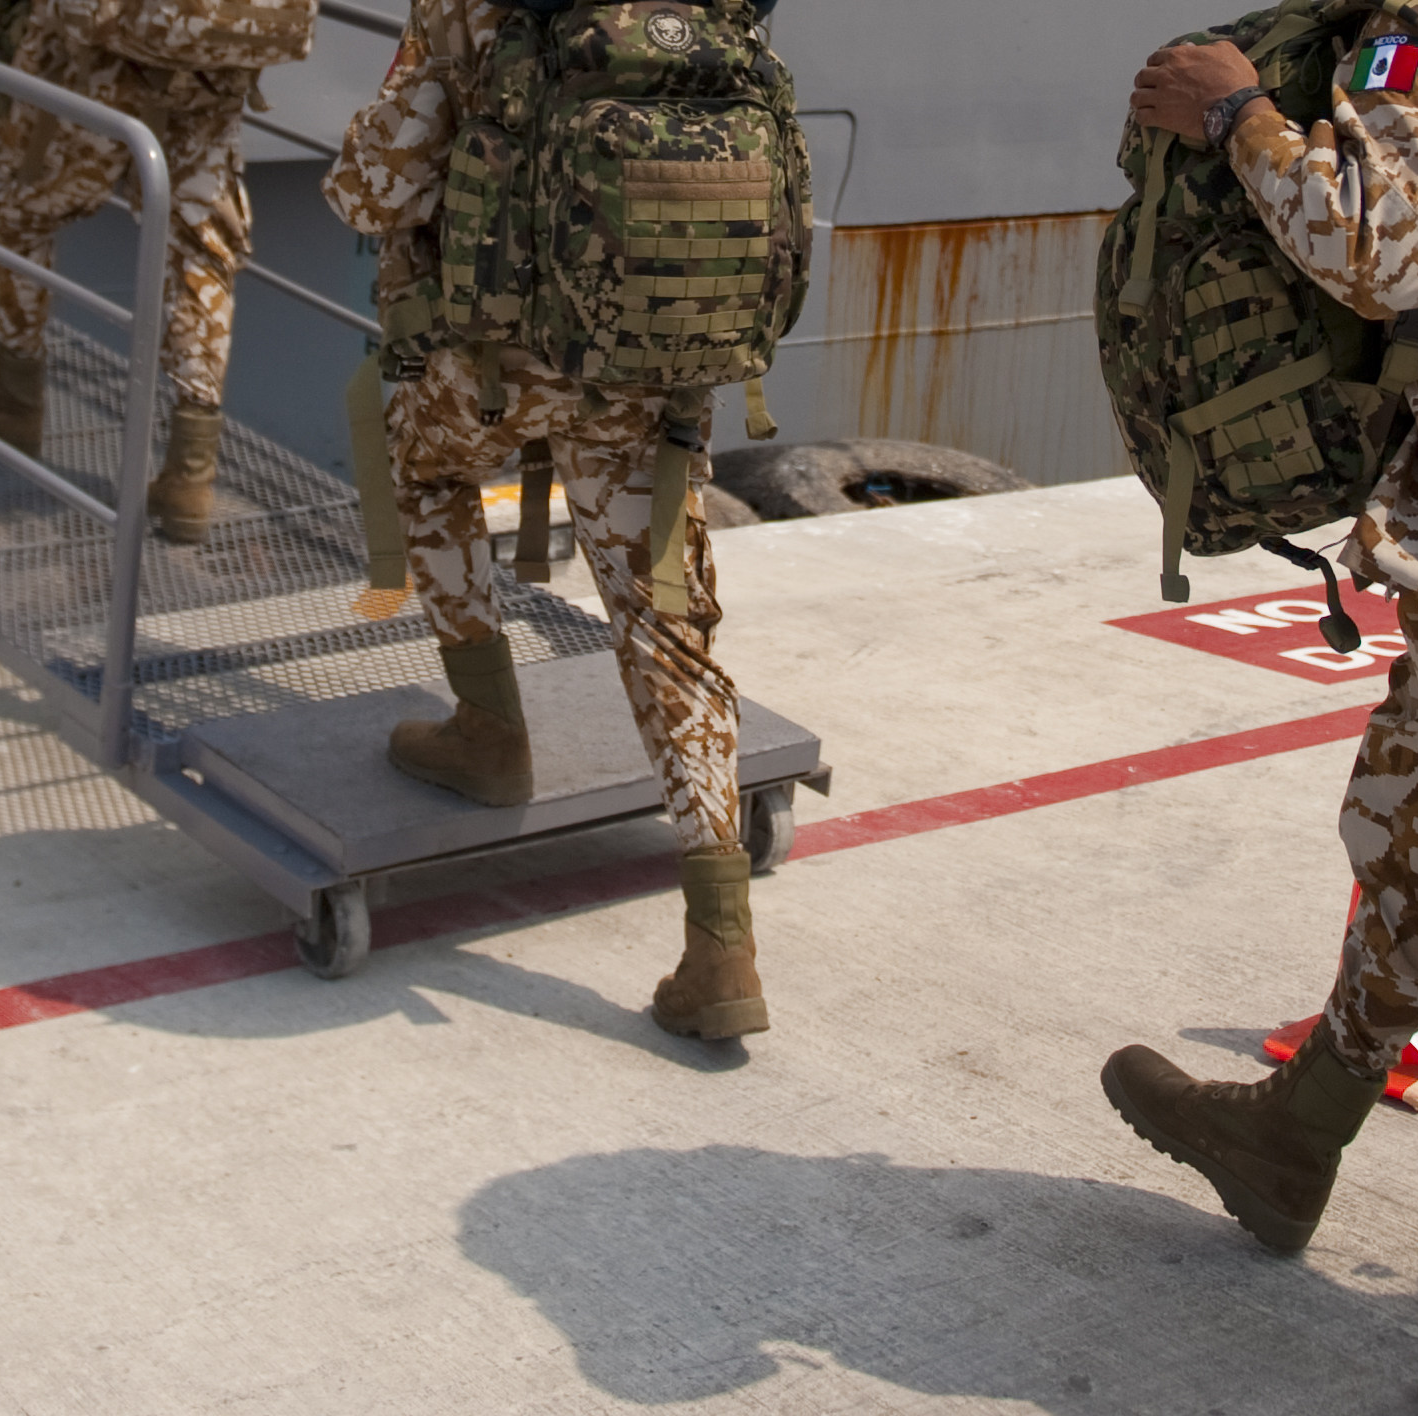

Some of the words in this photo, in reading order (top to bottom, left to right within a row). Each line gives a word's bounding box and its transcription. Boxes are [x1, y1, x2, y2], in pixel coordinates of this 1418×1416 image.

[1373, 35, 1408, 46] MEXICO
[1184, 599, 1331, 635] NO
[1278, 629, 1408, 671] DO
